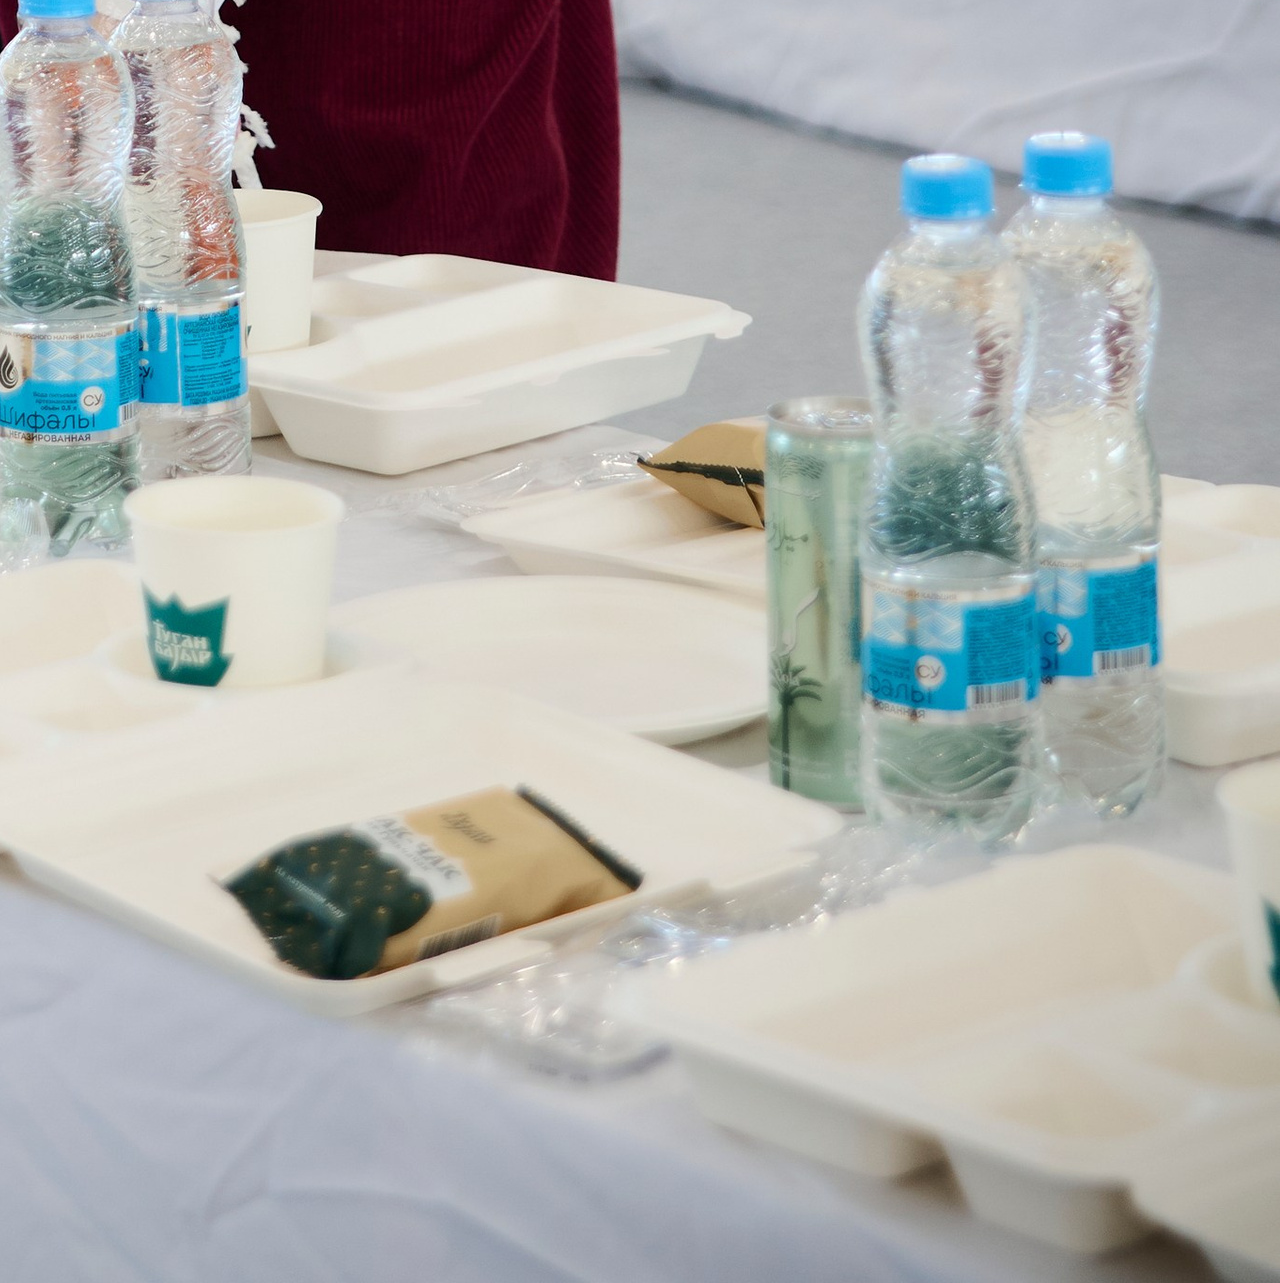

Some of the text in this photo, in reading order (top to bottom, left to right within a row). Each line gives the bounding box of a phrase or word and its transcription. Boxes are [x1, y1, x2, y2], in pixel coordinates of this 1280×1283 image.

[83, 393, 103, 407] СУ
[9, 430, 91, 443] НЕГАЗИРОВАННАЯ
[916, 664, 942, 679] СУ
